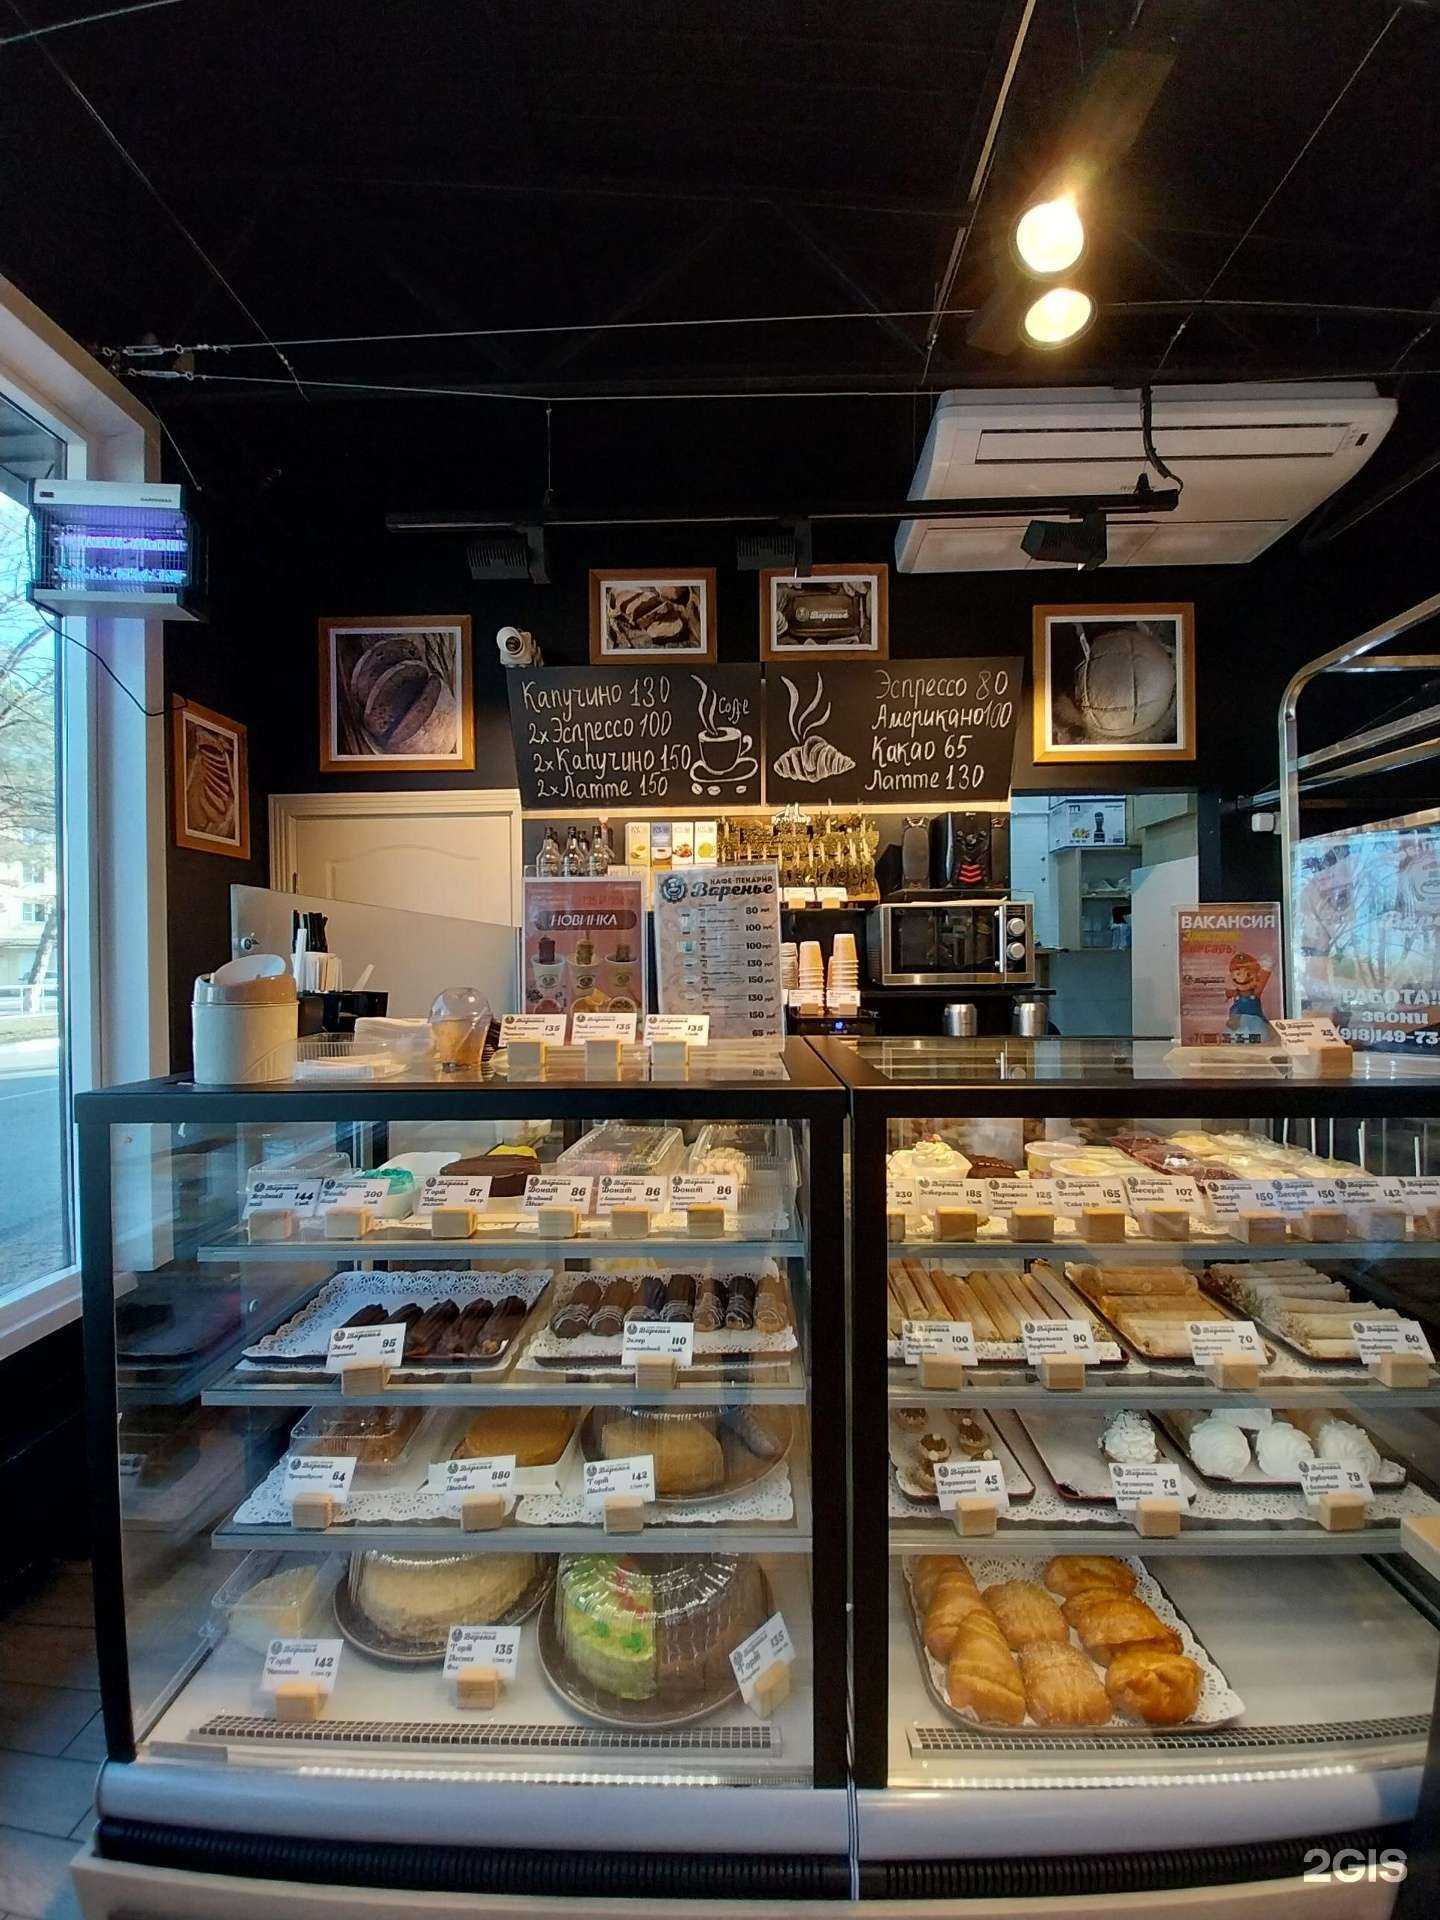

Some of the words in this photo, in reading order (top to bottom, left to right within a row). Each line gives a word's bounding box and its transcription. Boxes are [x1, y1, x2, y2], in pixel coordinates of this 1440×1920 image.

[875, 669, 967, 709] Эспрессо
[976, 670, 1008, 700] 80
[521, 681, 622, 721] Капучино
[630, 675, 670, 707] 130
[640, 711, 672, 737] 100
[872, 736, 935, 767] Какао
[945, 735, 973, 759] 65
[660, 744, 691, 771] 150
[865, 770, 939, 790] Латте
[946, 765, 984, 790] 130
[640, 774, 667, 796] 150
[691, 880, 775, 902] Варенье
[551, 915, 617, 926] НОВИНКА
[1181, 915, 1275, 929] ВАКАНСИЯ
[571, 1187, 586, 1196] 86
[645, 1187, 660, 1196] 86
[716, 1186, 731, 1195] 86
[1102, 1189, 1121, 1198] 165
[671, 1337, 686, 1345] 110
[1239, 1335, 1253, 1343] 70
[985, 1475, 998, 1484] 45
[1162, 1479, 1176, 1488] 78
[495, 1644, 513, 1654] 135
[315, 1657, 333, 1667] 142
